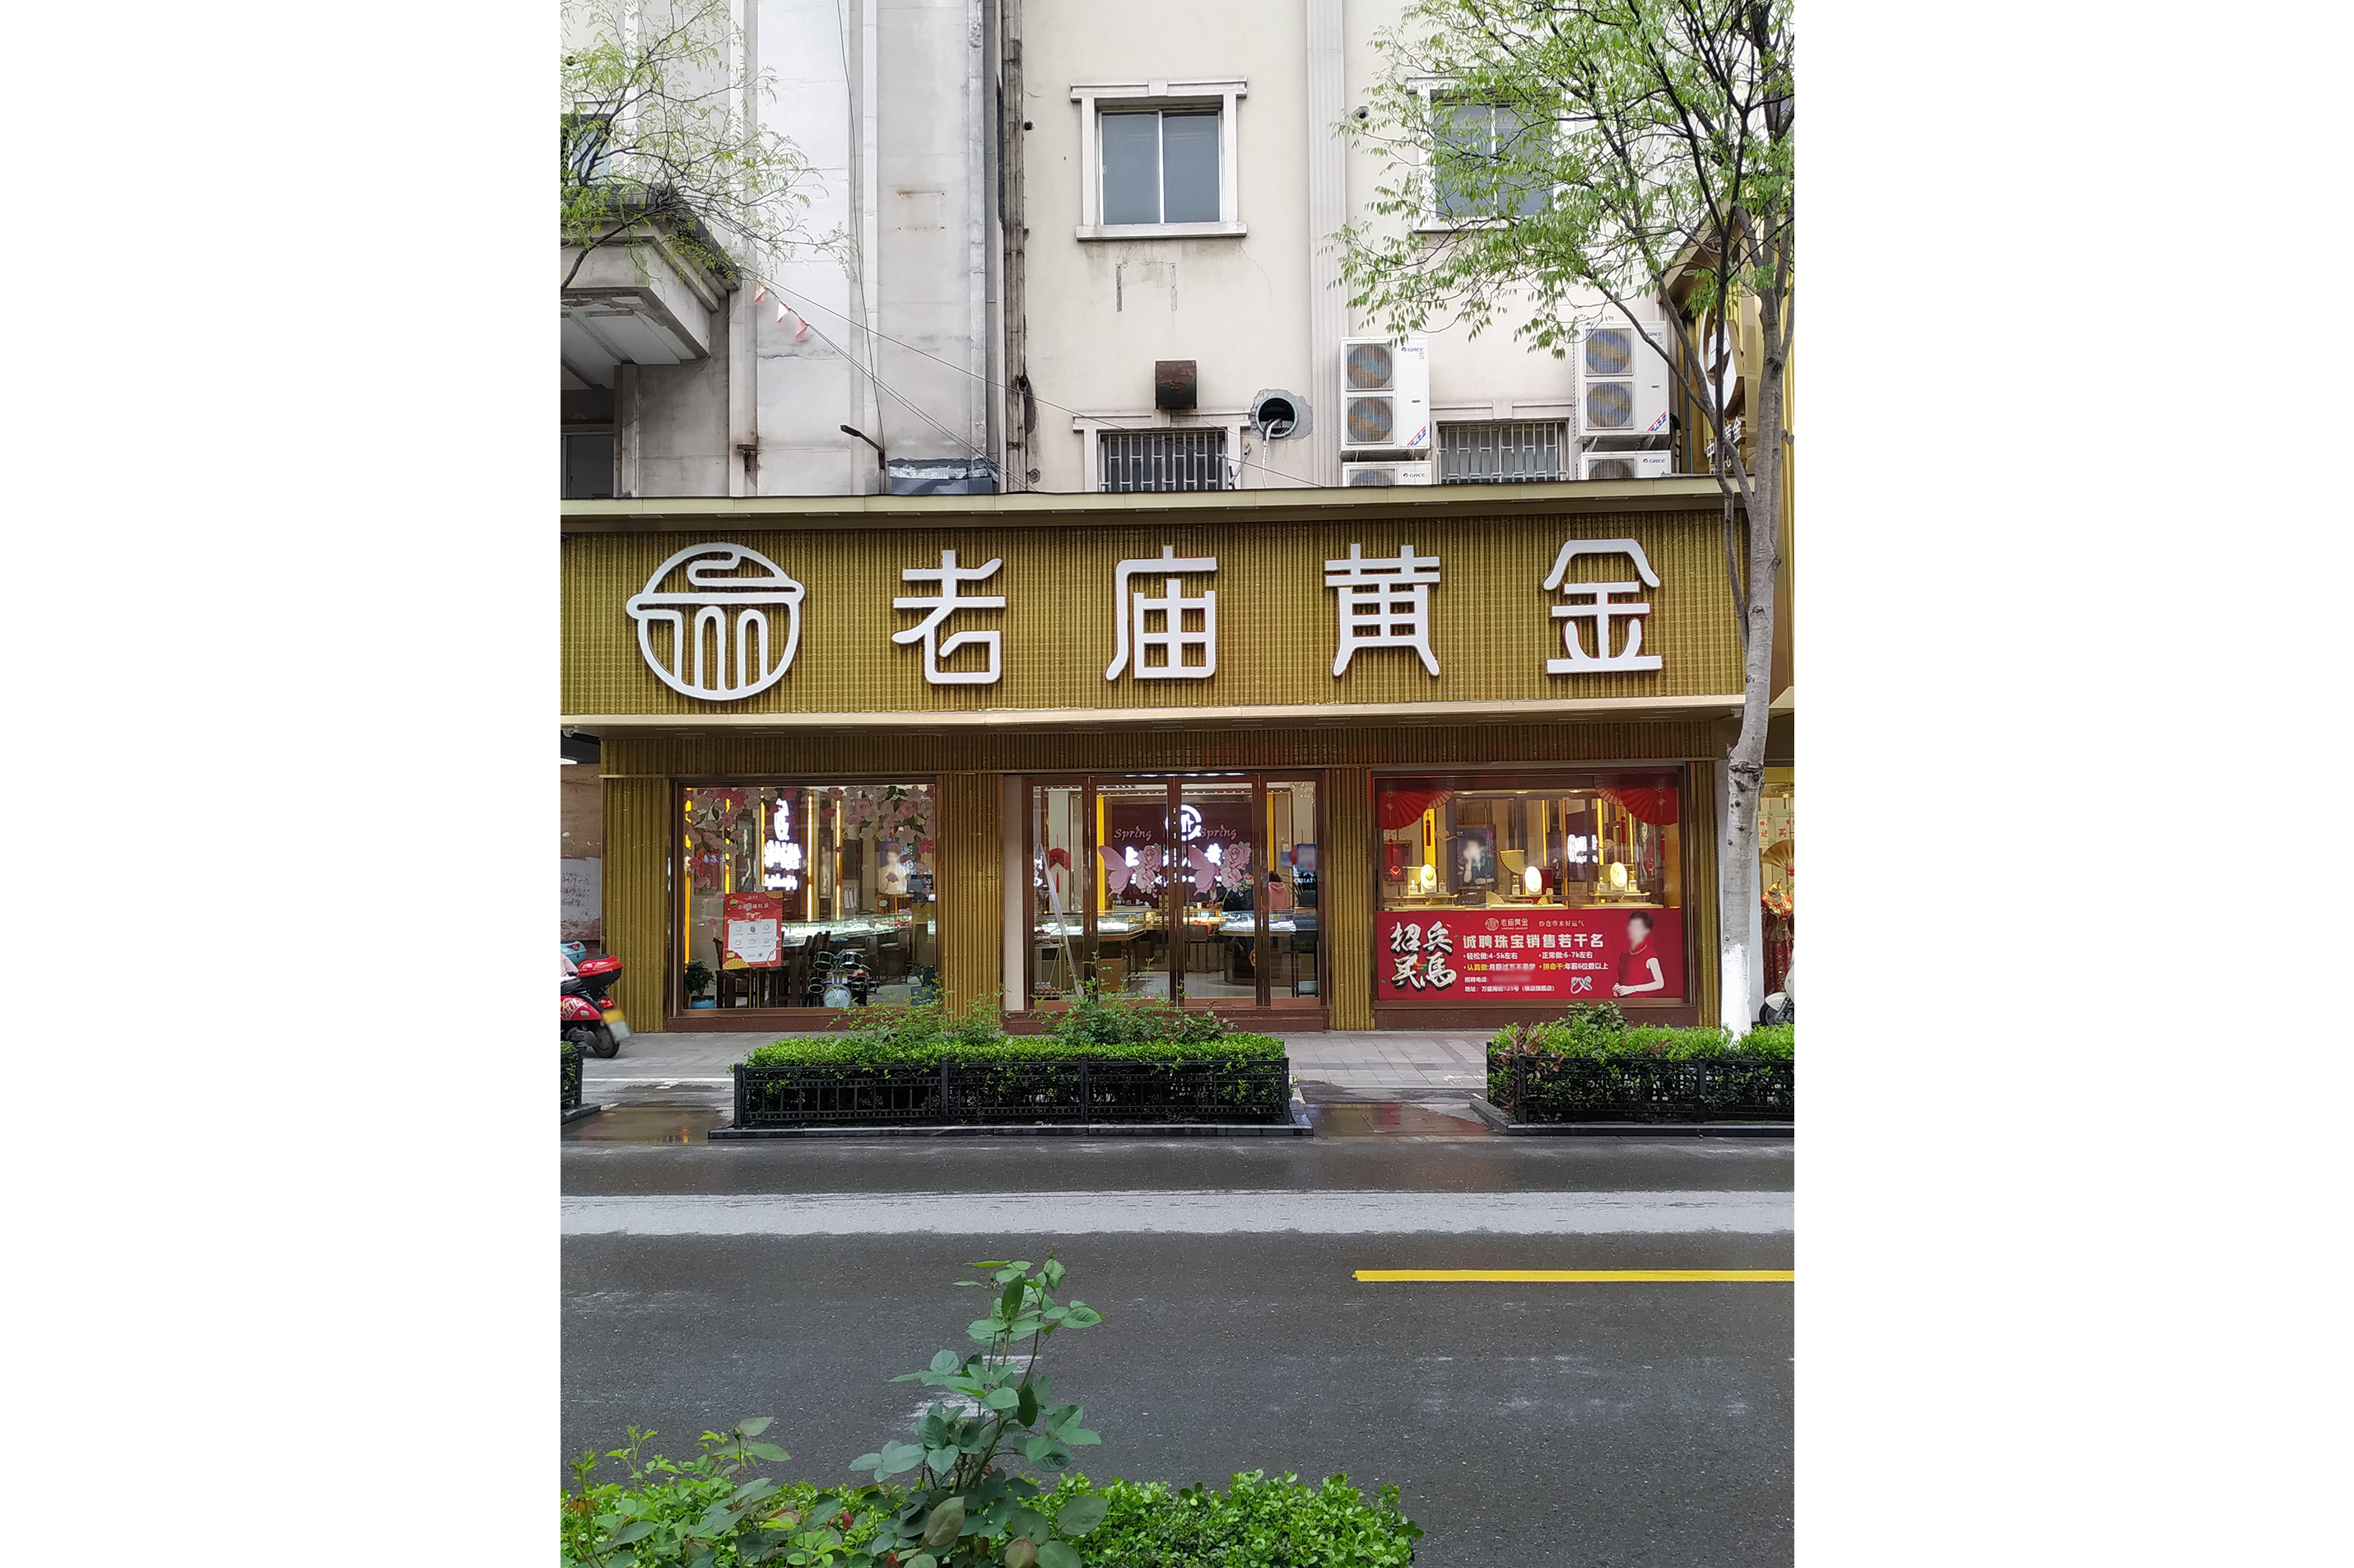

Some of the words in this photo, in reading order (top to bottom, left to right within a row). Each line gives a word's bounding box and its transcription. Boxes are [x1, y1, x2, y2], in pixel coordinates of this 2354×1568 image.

[1706, 416, 1742, 463] 中黄金
[892, 537, 1663, 685] 老庙黄金
[1114, 826, 1152, 841] Spring
[1200, 825, 1237, 840] Spring
[1500, 918, 1528, 927] 老庙黄金
[1538, 919, 1585, 928] 给您带来好运气
[1389, 920, 1454, 953] 招兵
[1463, 933, 1604, 949] 诚聘珠宝销售若干名
